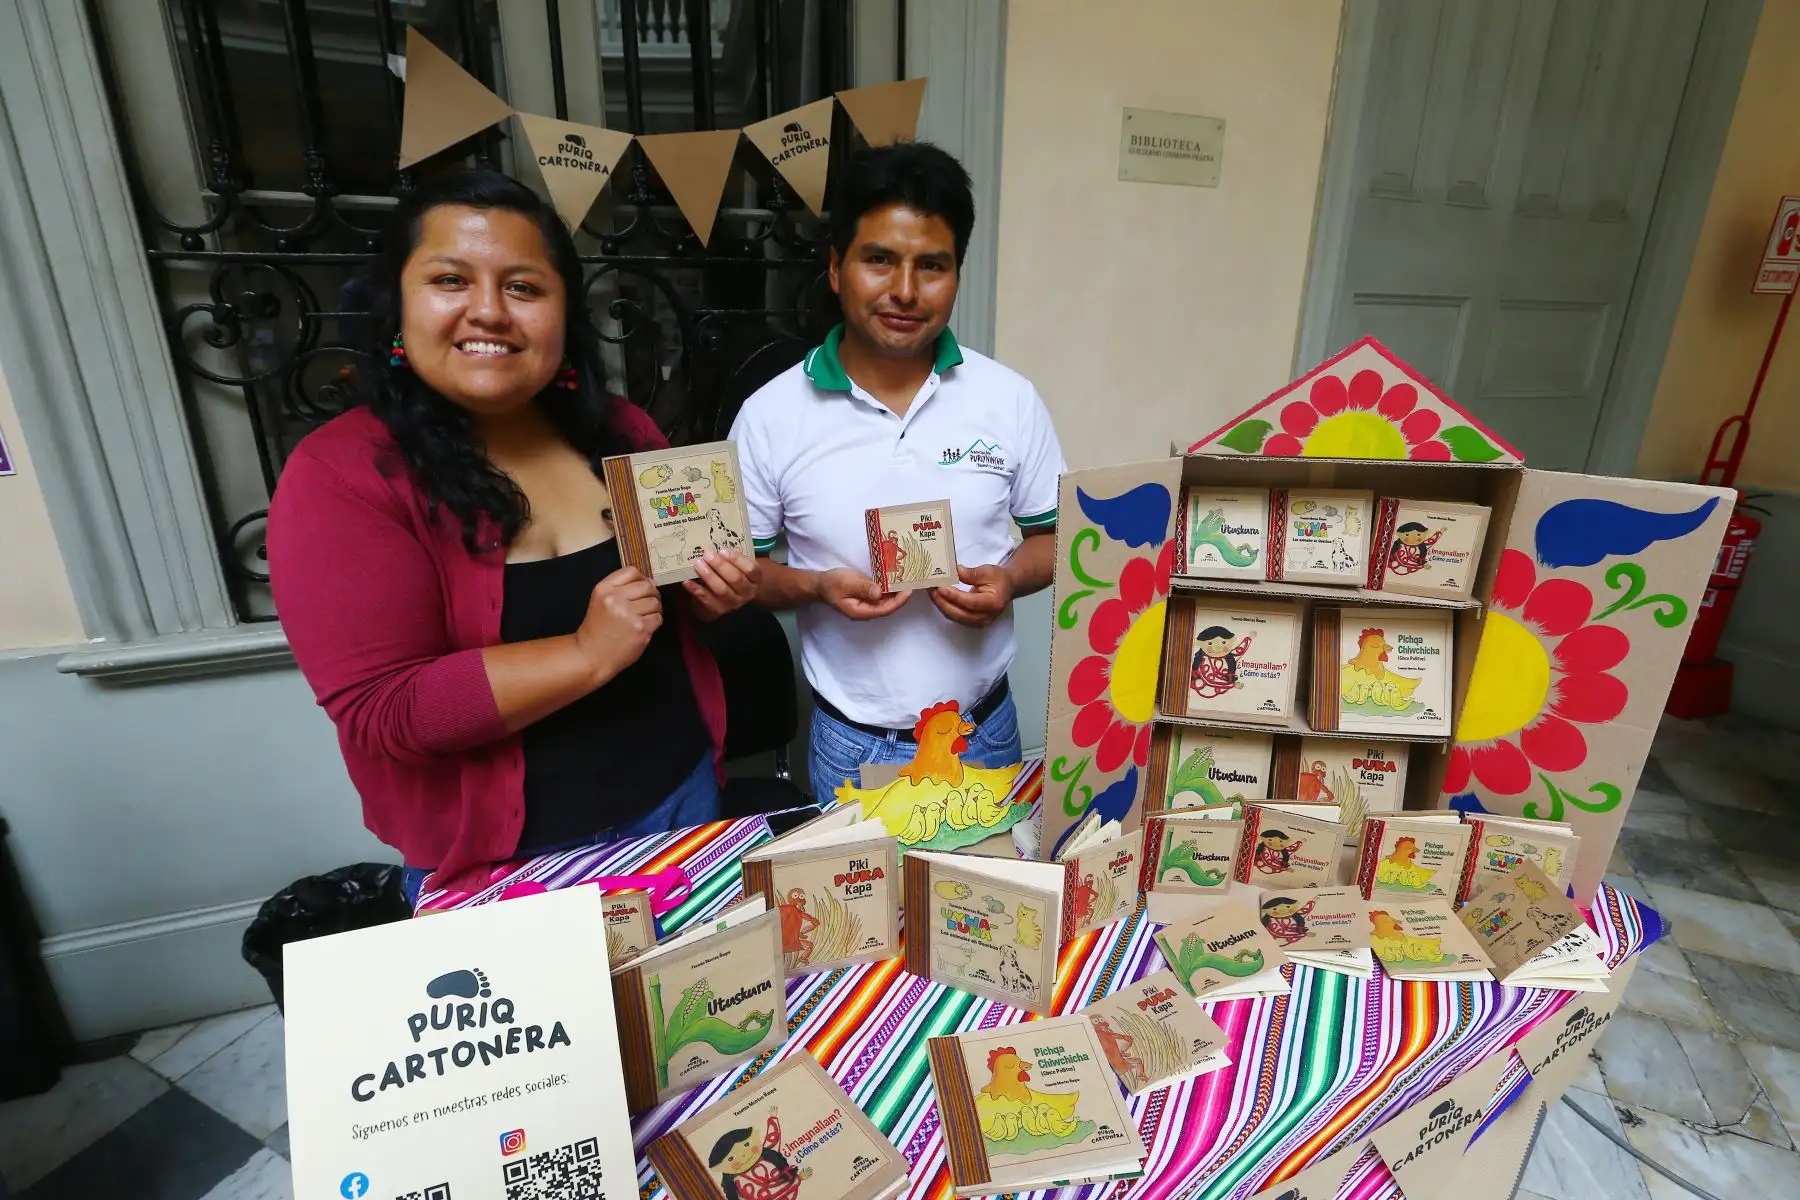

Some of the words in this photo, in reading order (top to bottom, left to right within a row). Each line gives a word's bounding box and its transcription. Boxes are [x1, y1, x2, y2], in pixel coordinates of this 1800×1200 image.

[781, 131, 811, 147] PURIQ
[1130, 134, 1201, 152] BIBLIOTECA
[558, 143, 592, 160] PURIQ
[772, 137, 828, 166] CARTONERA
[539, 156, 609, 175] CARTONERA
[913, 521, 942, 532] PUKA
[920, 530, 936, 538] Kapa
[1220, 524, 1260, 536] Utuskuru
[1428, 548, 1470, 558] ¿Imaynallam?
[1398, 634, 1424, 645] Pichqa
[1398, 646, 1440, 656] Chiwchicha
[1237, 660, 1288, 671] ¿Imaynallam?
[1240, 670, 1260, 678] ¿Cómo
[1367, 749, 1384, 759] Piki
[1352, 758, 1396, 772] PUKA
[1208, 767, 1258, 784] Utuskuru
[1360, 769, 1384, 781] Kapa
[849, 858, 868, 871] Piki
[1192, 852, 1230, 862] Utuskuru
[834, 867, 884, 887] PUKA
[845, 883, 872, 895] Kapa
[950, 933, 970, 942] animales
[1207, 928, 1257, 953] Utuskuru
[708, 980, 772, 1016] Utuskuru
[1142, 985, 1158, 997] Piki
[1137, 988, 1178, 1012] PUKA
[1151, 1000, 1174, 1014] Kapa
[407, 998, 514, 1042] PURIQ
[1557, 1012, 1595, 1044] PURIQ
[1034, 1046, 1065, 1057] Pichqa
[1532, 1012, 1611, 1076] CARTONERA
[351, 1021, 571, 1102] CARTONERA
[1038, 1053, 1089, 1068] Chiwchicha
[413, 1111, 429, 1123] en
[433, 1094, 488, 1118] nuestras
[492, 1086, 521, 1102] redes
[1420, 1106, 1463, 1140] PURIQ
[782, 1109, 842, 1157] ¿Imaynallam?
[1392, 1109, 1482, 1172] CARTONERA
[795, 1142, 818, 1164] ¿Cómo
[820, 1122, 843, 1144] estás?
[850, 1158, 879, 1181] CARTONERA
